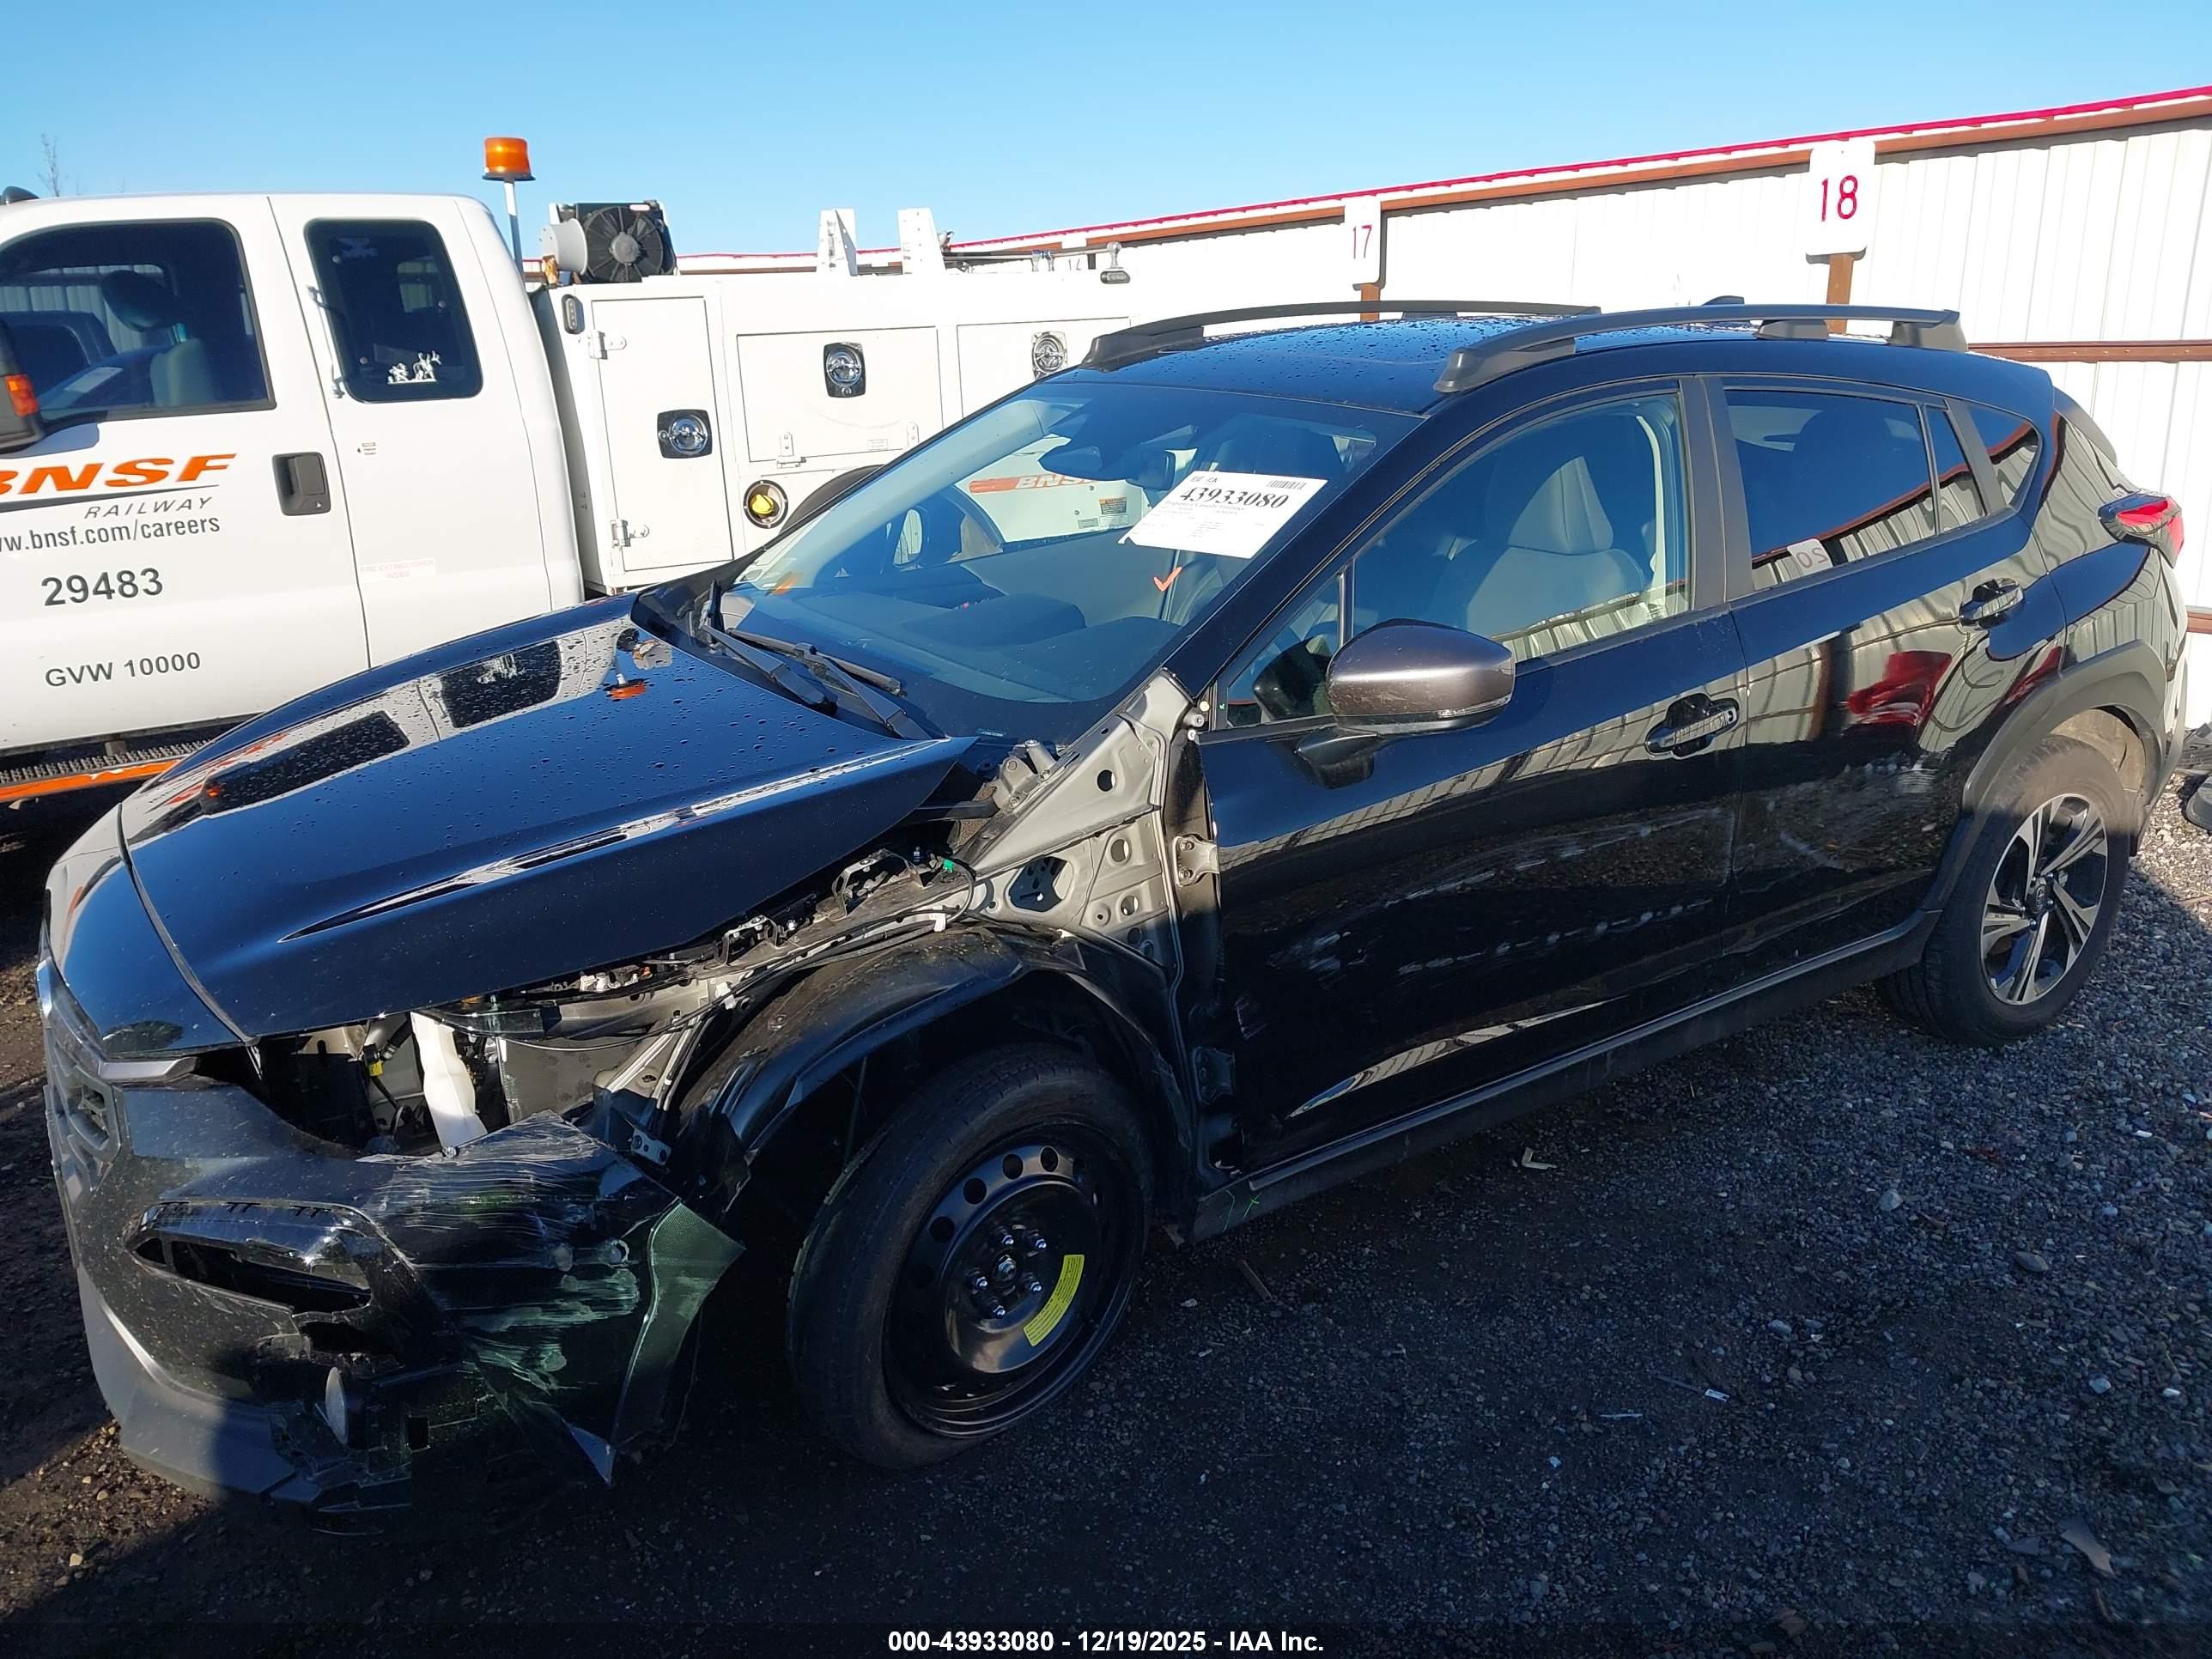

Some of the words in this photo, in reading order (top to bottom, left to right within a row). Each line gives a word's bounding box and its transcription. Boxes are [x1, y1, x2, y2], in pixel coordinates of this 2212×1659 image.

[1820, 175, 1858, 222] 18
[1352, 224, 1372, 259] 17
[84, 496, 212, 519] RAILWAY
[1179, 485, 1290, 509] 43933080
[0, 516, 221, 552] w.bnsf.com/careers
[40, 568, 163, 606] 29483
[45, 662, 113, 687] GVW
[124, 652, 201, 678] 10000
